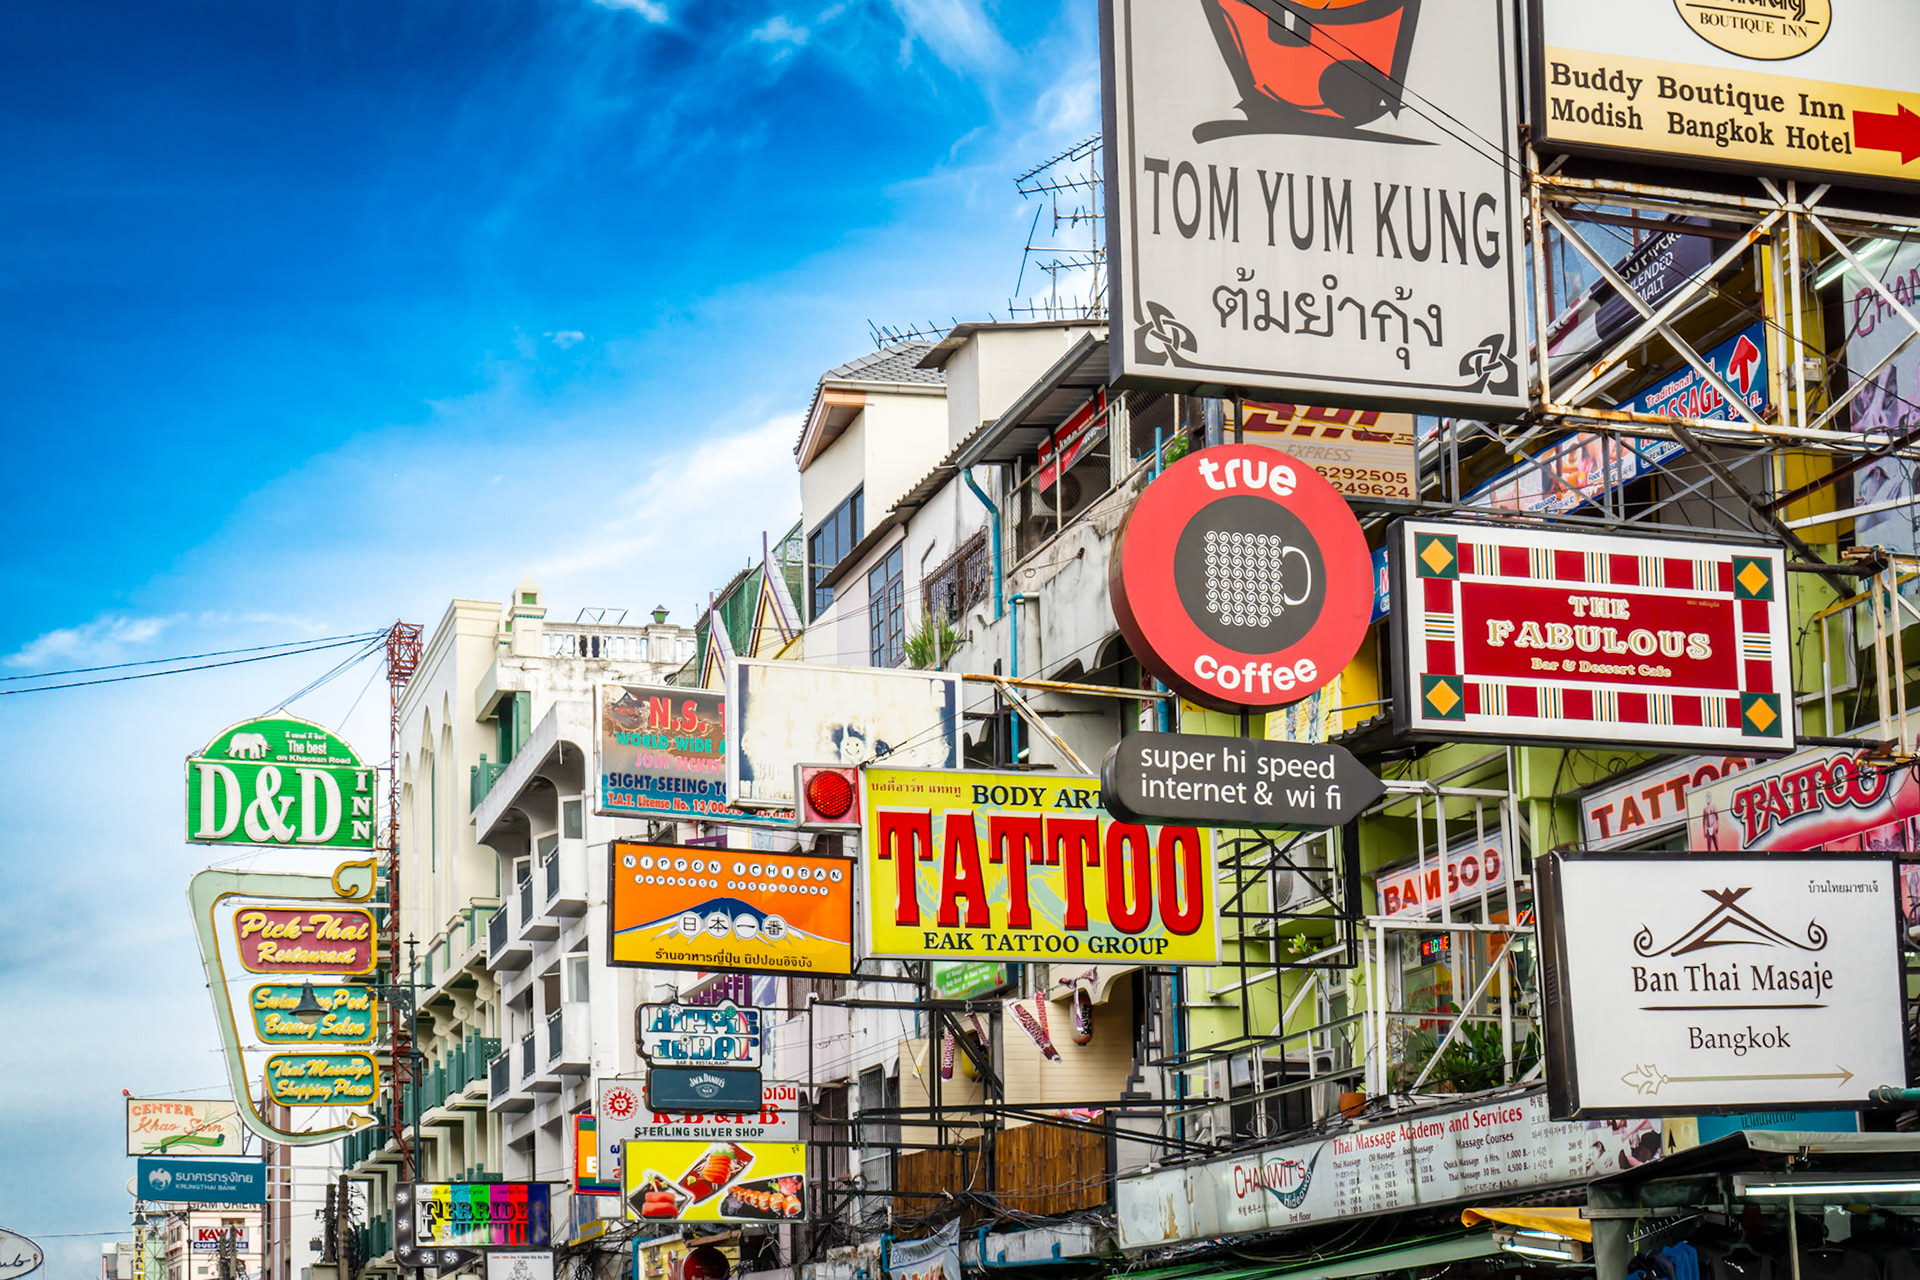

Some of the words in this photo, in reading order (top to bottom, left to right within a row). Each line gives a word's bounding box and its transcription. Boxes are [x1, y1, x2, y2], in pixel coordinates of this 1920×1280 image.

[1700, 12, 1775, 34] BOUTIQUE
[1782, 24, 1808, 38] INN
[1550, 62, 1643, 101] Buddy
[1657, 75, 1785, 113] Boutique
[1798, 93, 1846, 120] Inn
[1550, 97, 1644, 130] Modish
[1667, 111, 1774, 148] Bangkok
[1786, 125, 1852, 155] Hotel
[1143, 155, 1240, 243] TOM
[1256, 169, 1354, 255] YUM
[1373, 181, 1501, 269] KUNG
[1212, 267, 1444, 370] ต้มยำกุ้ง
[1645, 371, 1693, 409] Traditional
[1285, 443, 1354, 463] EXPRESS
[1198, 456, 1297, 496] true
[1567, 595, 1631, 620] THE
[1486, 619, 1713, 661] FABULOUS
[1194, 653, 1318, 694] coffee
[1531, 656, 1560, 671] Bar
[1562, 659, 1577, 672] &
[1578, 659, 1637, 676] Dessert
[1638, 663, 1672, 678] Cafe
[287, 740, 305, 753] The
[306, 741, 327, 755] best
[615, 731, 669, 750] WORLD
[675, 737, 712, 753] WIDE
[328, 756, 351, 765] Road
[635, 753, 670, 770] JOIN
[675, 756, 722, 773] TICKET
[1141, 748, 1216, 774] super
[1222, 748, 1247, 774] hi
[1257, 755, 1335, 786] speed
[609, 772, 652, 789] SIGHT
[658, 777, 710, 795] SEEING
[1141, 774, 1247, 805] internet
[1253, 781, 1273, 806] &
[1286, 785, 1315, 809] wi
[1326, 785, 1342, 810] fi
[194, 764, 342, 843] D&D
[350, 772, 371, 840] INN
[637, 795, 671, 810] License
[673, 798, 690, 812] No.
[971, 785, 1047, 807] BODY
[1731, 750, 1893, 848] TATTOO
[623, 855, 721, 874] NIPPON
[733, 862, 842, 882] ICHIBAN
[876, 805, 1204, 936] TATTOO
[636, 875, 717, 888] JAPANESE
[728, 882, 828, 895] RESTAURANT
[1383, 848, 1500, 917] BAMBOO
[240, 912, 369, 940] Pick-Thai
[681, 912, 785, 938] 日本一番
[257, 941, 357, 964] Restaurant
[923, 932, 975, 951] EAK
[980, 933, 1079, 954] TATTOO
[1087, 935, 1169, 956] GROUP
[1631, 965, 1679, 993] Ban
[1683, 963, 1741, 992] Thai
[1750, 961, 1834, 999] Masaje
[332, 988, 370, 1010] Pool
[320, 1014, 366, 1035] Salon
[646, 1006, 760, 1035] HIPPIE
[1688, 1025, 1791, 1057] Bangkok
[270, 1060, 306, 1078] Thai
[306, 1059, 371, 1081] Massage
[689, 1075, 702, 1088] JACK
[276, 1079, 333, 1101] Shopping
[333, 1078, 372, 1097] Plaza
[131, 1103, 194, 1117] CENTER
[132, 1115, 180, 1134] Khao
[183, 1117, 225, 1134] Sarn
[634, 1126, 690, 1137] STERLING
[693, 1127, 733, 1138] SILVER
[735, 1128, 765, 1138] SHOP
[1332, 1136, 1353, 1156] Thai
[1355, 1130, 1397, 1149] Massage
[1399, 1121, 1446, 1141] Academy
[1448, 1112, 1470, 1133] and
[1472, 1106, 1524, 1129] Services
[1456, 1137, 1484, 1150] Massage
[1485, 1132, 1514, 1145] Courses
[1376, 1151, 1396, 1161] Massage
[1443, 1161, 1458, 1171] Quick
[1459, 1157, 1480, 1167] Massage
[1448, 1173, 1459, 1182] Thai
[1460, 1170, 1481, 1180] Massage
[1483, 1167, 1490, 1177] 30
[175, 1183, 217, 1191] KRUNGTHAI
[1289, 1213, 1299, 1223] 3rd
[1298, 1212, 1312, 1222] floor
